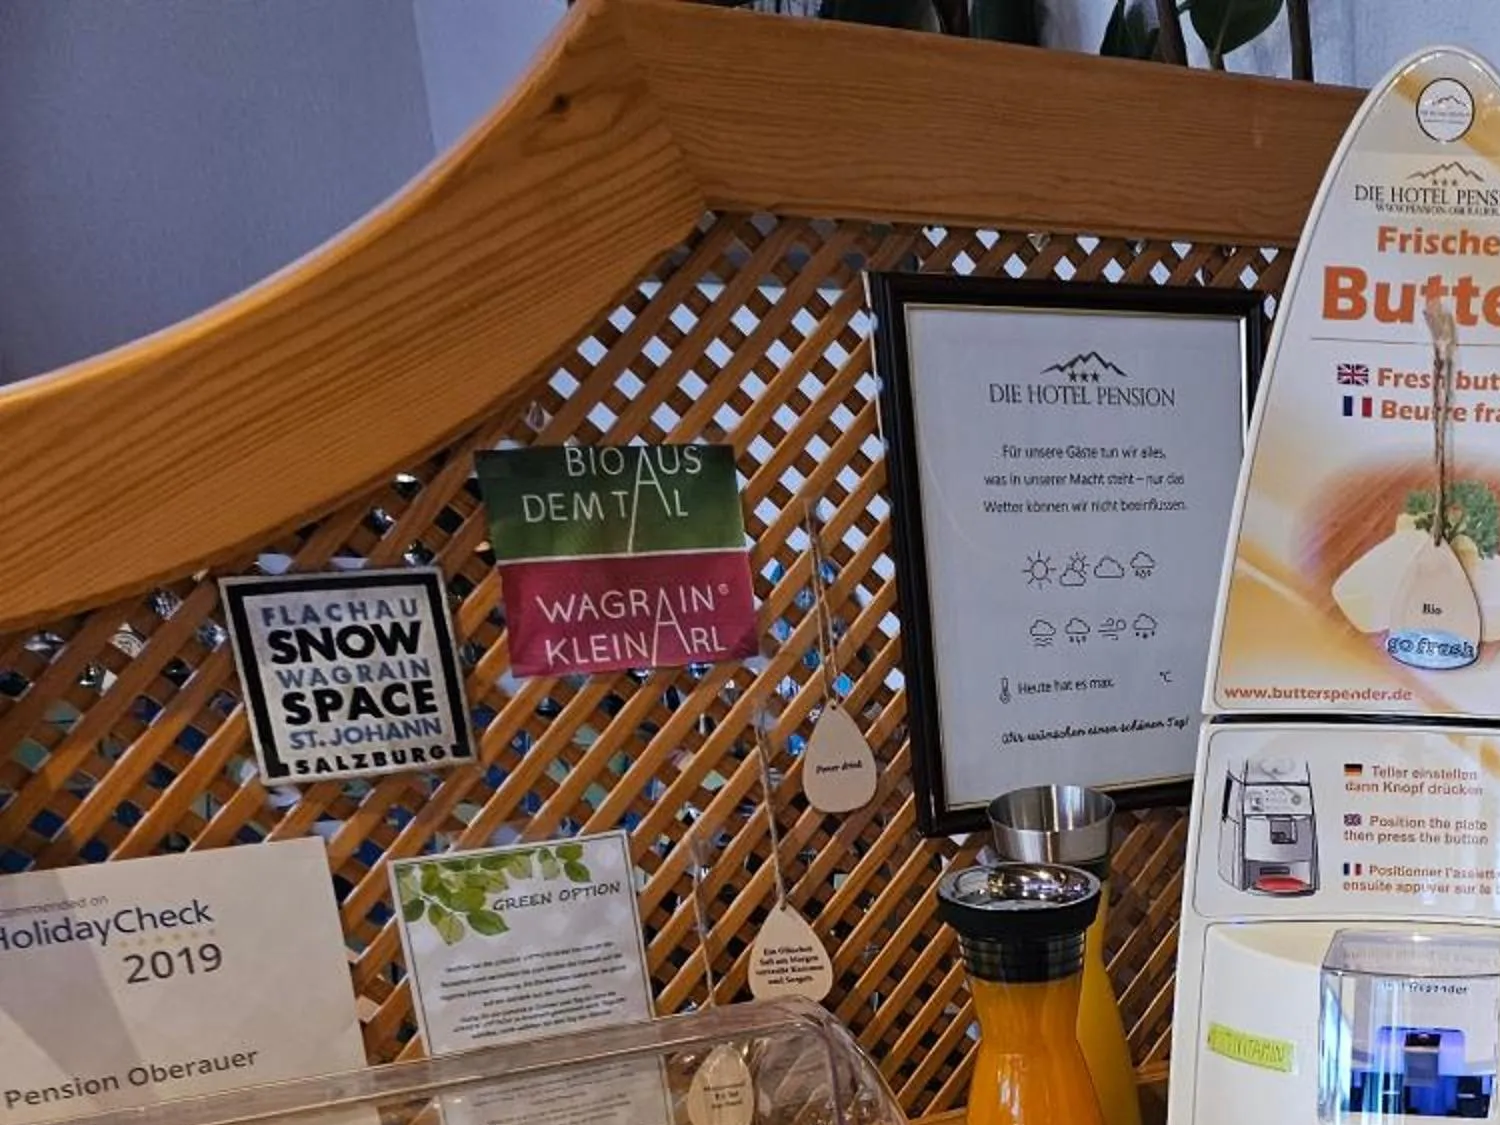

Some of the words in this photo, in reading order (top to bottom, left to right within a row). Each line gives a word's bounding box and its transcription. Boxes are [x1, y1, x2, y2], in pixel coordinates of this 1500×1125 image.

[1354, 184, 1384, 201] DIE
[1391, 186, 1450, 204] HOTEL
[989, 383, 1021, 403] DIE
[1027, 384, 1090, 405] HOTEL
[1097, 386, 1176, 407] PENSION
[564, 446, 626, 476] BIO
[523, 493, 605, 523] DEM
[261, 597, 419, 628] FLACHAU
[536, 588, 717, 625] WAGRAIN
[269, 620, 421, 664] SNOW
[546, 622, 727, 667] KLEINARL
[1387, 637, 1414, 654] go
[275, 657, 432, 689] WAGRAIN
[281, 685, 438, 725] SPACE
[1223, 685, 1413, 702] www.butterspender.de
[289, 727, 327, 750] ST.
[330, 716, 442, 747] JOHANN
[294, 744, 447, 776] SALZBURG
[1371, 765, 1407, 779] Teller
[1412, 767, 1478, 781] einstellen
[1345, 781, 1379, 793] dann
[1383, 781, 1425, 796] Knopf
[1344, 829, 1374, 842] then
[1377, 832, 1416, 845] press
[1420, 832, 1441, 844] the
[1444, 833, 1489, 845] button
[1369, 815, 1427, 828] Position
[1429, 816, 1451, 829] the
[1455, 818, 1488, 831] plate
[492, 891, 553, 912] GREEN
[558, 881, 621, 901] OPTION
[1343, 881, 1393, 892] ensuite
[122, 942, 224, 984] 2019
[4, 1074, 121, 1110] Pension
[128, 1049, 259, 1088] Oberauer
